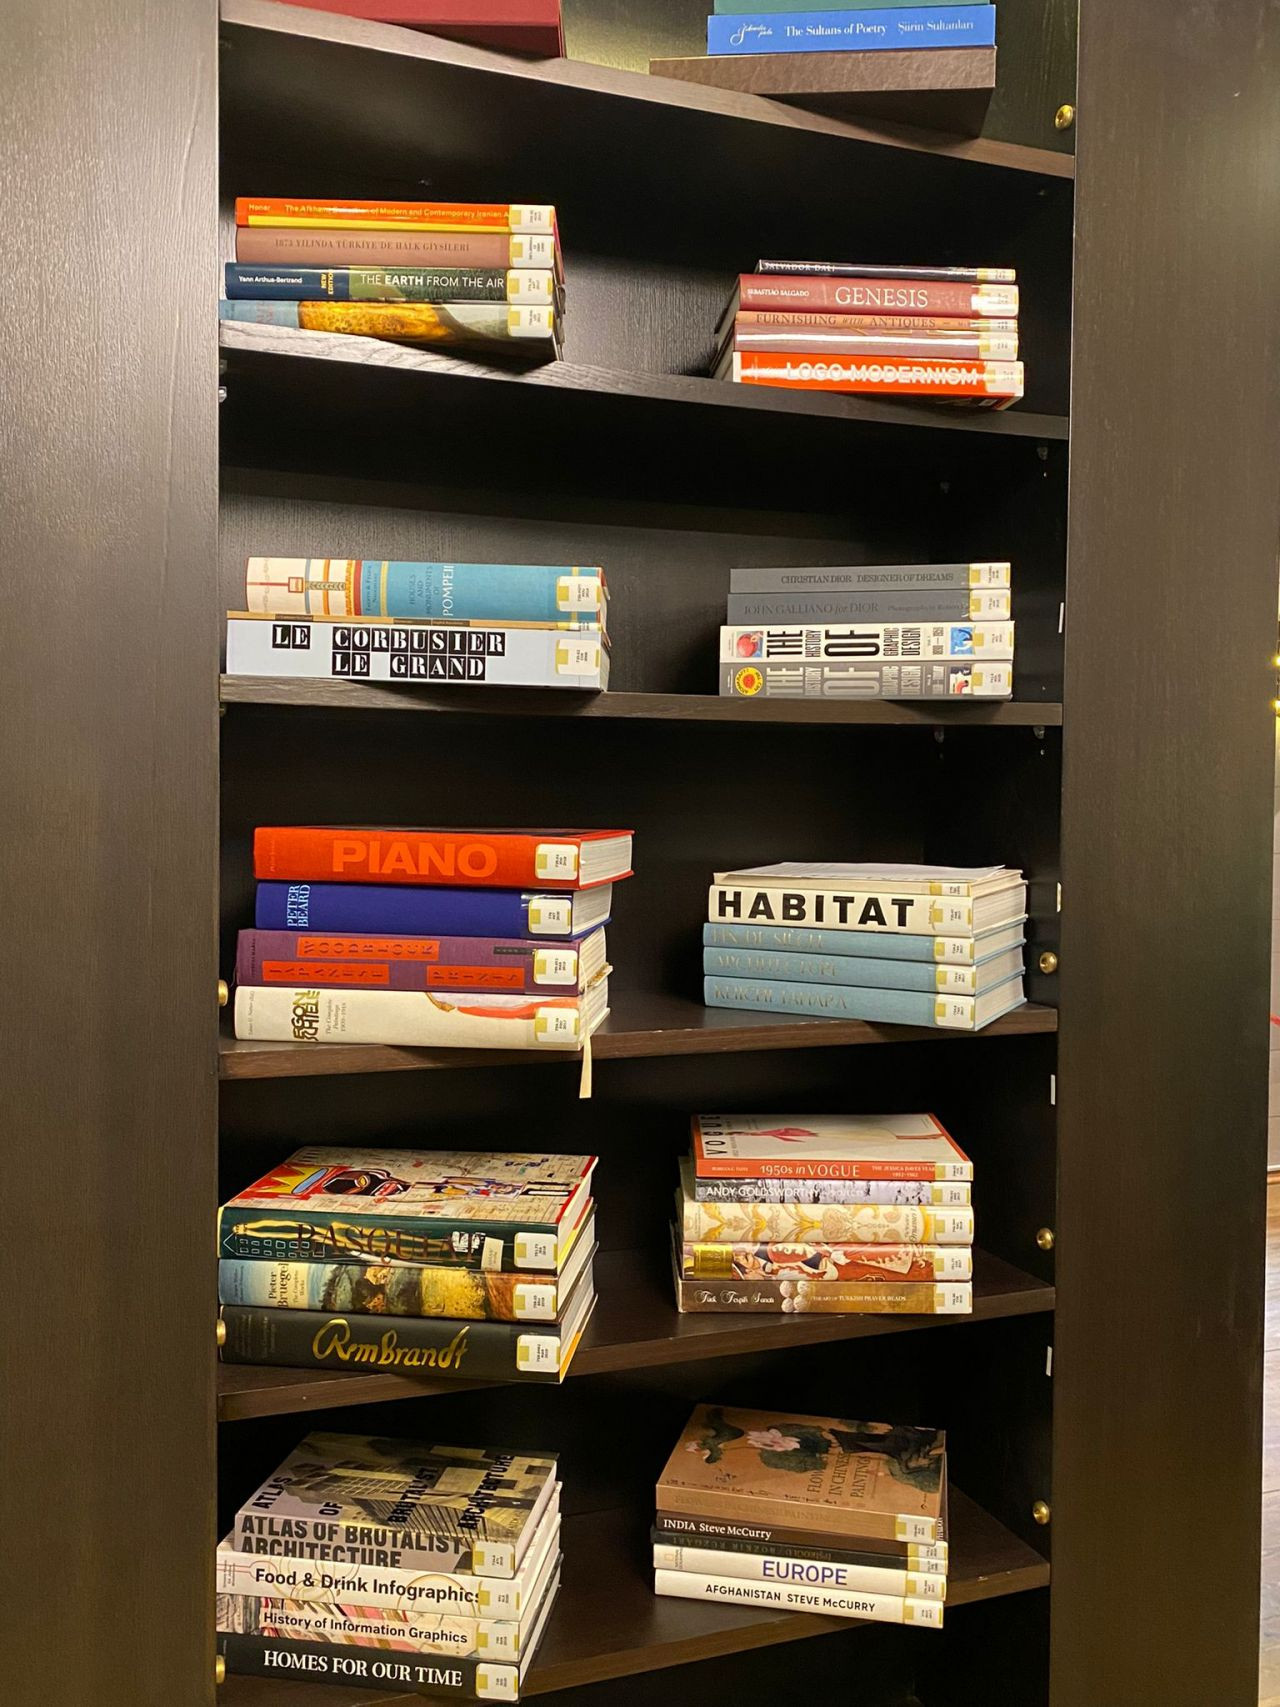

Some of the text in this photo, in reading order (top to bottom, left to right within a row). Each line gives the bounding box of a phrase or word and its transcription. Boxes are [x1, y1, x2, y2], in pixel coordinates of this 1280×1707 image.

[784, 23, 888, 37] The Sultans of Poetry
[285, 204, 300, 213] The
[380, 207, 408, 217] Modern
[409, 208, 422, 216] and
[423, 209, 476, 218] Contemporary
[295, 239, 334, 249] YILINDA
[395, 242, 421, 251] HALK
[238, 275, 303, 285] Yann Arthus-Bertrand
[320, 273, 328, 289] NEW
[360, 273, 505, 289] THE EARTH FROM THE AIR
[780, 289, 810, 298] SALGADO
[835, 286, 929, 308] GENESIS
[755, 312, 837, 326] FURNISHING
[869, 316, 937, 329] ANTIQUES
[785, 361, 978, 386] LOGO MODERNISM
[416, 579, 424, 598] AND
[424, 565, 434, 615] MONUMENTS
[442, 564, 455, 617] POMPEII
[780, 573, 954, 584] CHRISTIAN DIOR DESIGNER OF DREAMS
[744, 604, 774, 616] JOHN
[775, 603, 834, 615] GALLIANO
[834, 604, 848, 616] for
[850, 602, 879, 613] DIOR
[272, 624, 505, 656] LE CORBUSIER
[766, 629, 803, 658] THE
[804, 629, 822, 658] HISTORY
[824, 629, 880, 657] OF
[883, 627, 900, 657] GRAPHIC
[901, 626, 921, 656] DESIGN
[332, 650, 486, 680] LE GRAND
[766, 666, 804, 696] THE
[822, 666, 880, 696] OF
[332, 840, 498, 878] PIANO
[287, 884, 300, 927] PETER
[298, 884, 311, 928] BEARD
[718, 890, 914, 928] HABITAT
[303, 941, 434, 955] WOODBLOCK
[712, 927, 738, 942] FIN
[432, 971, 520, 983] PRINTS
[291, 990, 306, 1041] EGON
[302, 990, 320, 1041] SCHIELE
[700, 1115, 728, 1156] VOGUE
[760, 1164, 793, 1176] 1950s
[795, 1163, 806, 1175] in
[807, 1164, 861, 1177] VOGUE
[706, 1186, 737, 1197] ANDY
[738, 1185, 819, 1198] GOLDSWORTHY
[268, 1271, 277, 1300] Pieter
[277, 1262, 291, 1309] Bruegel
[251, 1476, 293, 1510] ATLAS
[827, 1480, 843, 1497] IN
[318, 1501, 343, 1516] OF
[241, 1514, 461, 1555] ATLAS OF BRUTALIST
[663, 1518, 772, 1541] INDIA Steve McCurry
[240, 1536, 402, 1568] ARCHITECTURE
[255, 1568, 297, 1585] Food
[302, 1572, 315, 1588] &
[321, 1574, 368, 1593] Drink
[763, 1560, 848, 1586] EUROPE
[705, 1583, 876, 1612] AFGHANISTAN STEVE McCURRY
[263, 1611, 468, 1644] History of Information Graphics
[263, 1650, 463, 1687] HOMES FOR OUR TIME
